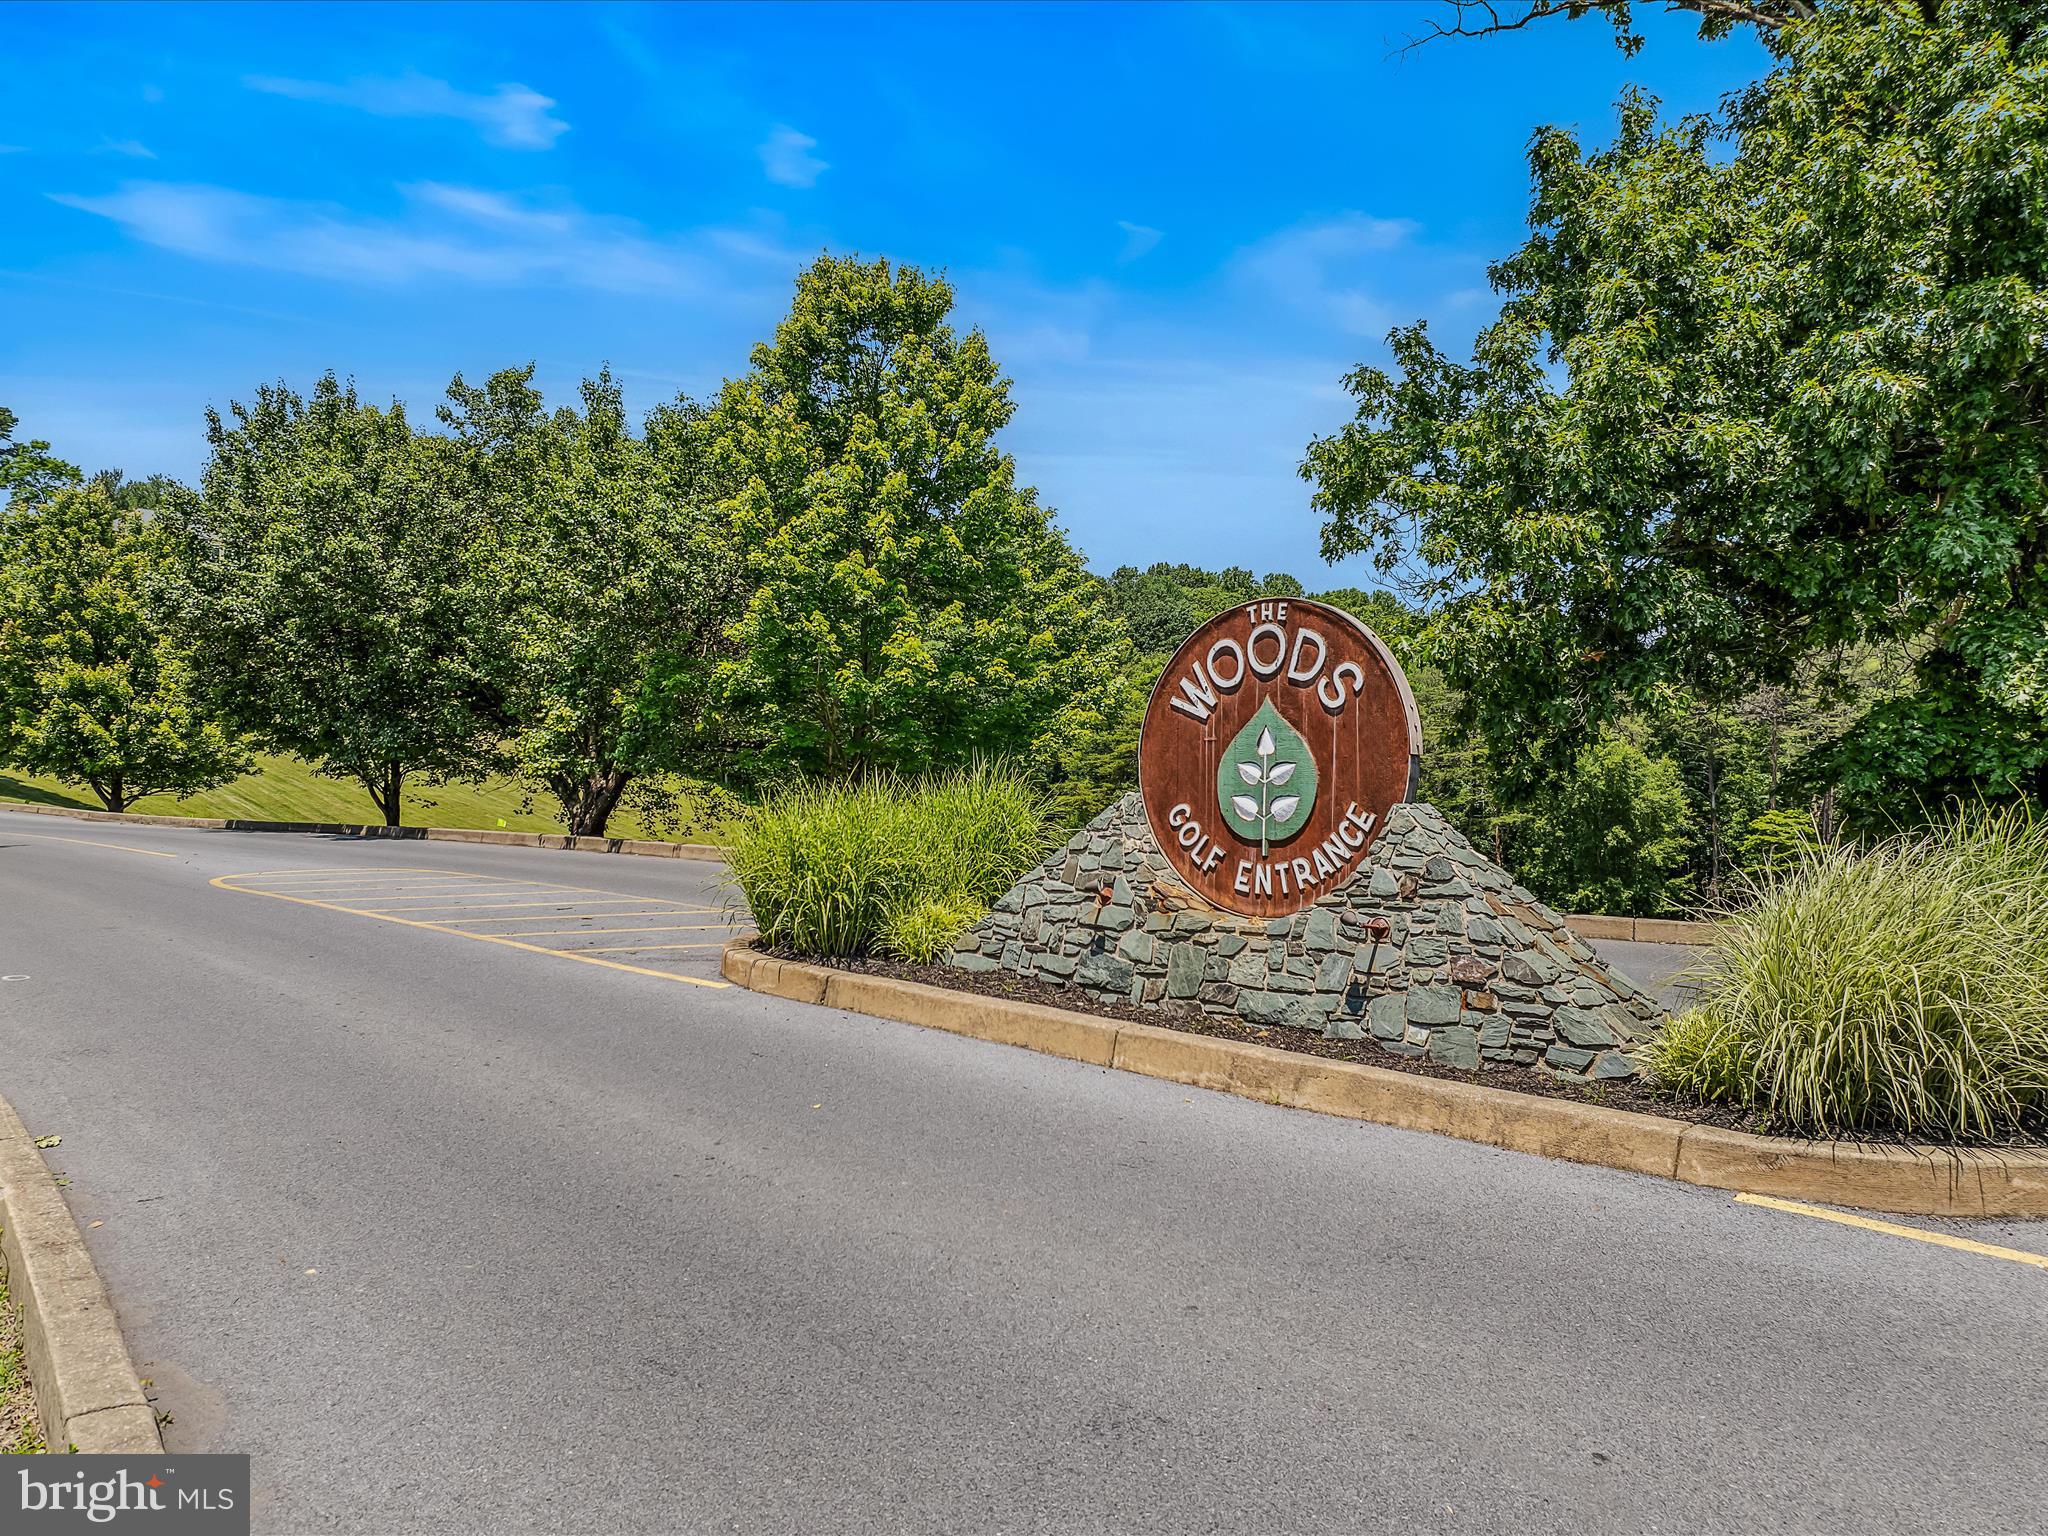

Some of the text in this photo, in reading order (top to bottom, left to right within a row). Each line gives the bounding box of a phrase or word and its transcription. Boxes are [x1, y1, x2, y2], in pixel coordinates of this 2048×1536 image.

[1246, 602, 1288, 624] THE
[1170, 623, 1364, 720] WOODS
[1169, 801, 1377, 895] GOLF ENTRANCE
